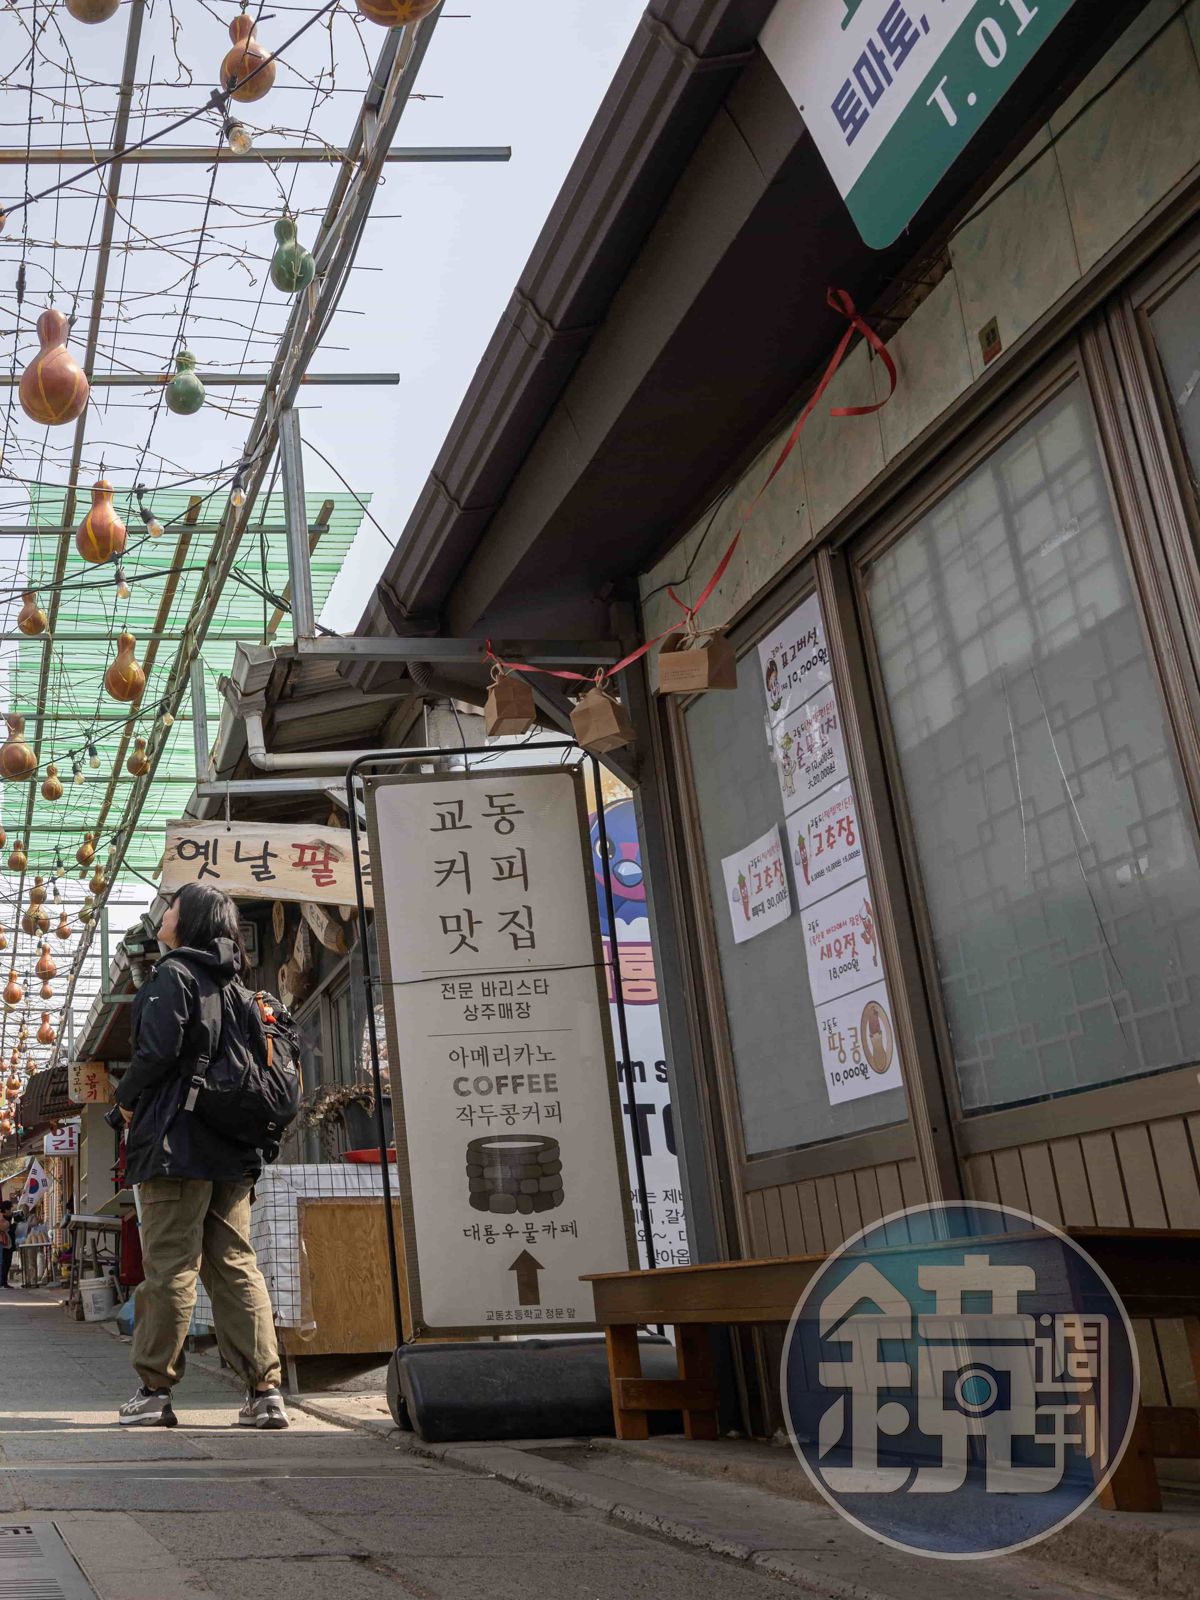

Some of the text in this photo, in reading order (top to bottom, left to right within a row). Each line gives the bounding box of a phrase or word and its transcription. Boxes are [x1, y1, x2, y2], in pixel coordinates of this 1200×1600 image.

[781, 627, 819, 669] 표고버섯
[787, 648, 830, 690] 10,000원
[430, 793, 525, 835] 교동
[813, 816, 856, 857] 고추장
[434, 847, 529, 895] 커피
[753, 858, 785, 894] 고추장
[439, 904, 536, 954] 맛집
[820, 932, 859, 961] 새우젓
[828, 958, 860, 980] 18,000원
[441, 978, 550, 1000] 전문 바리스타
[463, 1001, 531, 1022] 상주매장
[448, 1043, 557, 1069] 아메리카노
[828, 1026, 861, 1065] 땅콩
[453, 1073, 559, 1097] COFFEE
[831, 1063, 870, 1086] 10,000원
[455, 1100, 562, 1127] 작두콩커피
[462, 1219, 578, 1245] 대룡우물카페
[485, 1309, 542, 1321] 교동초등학교
